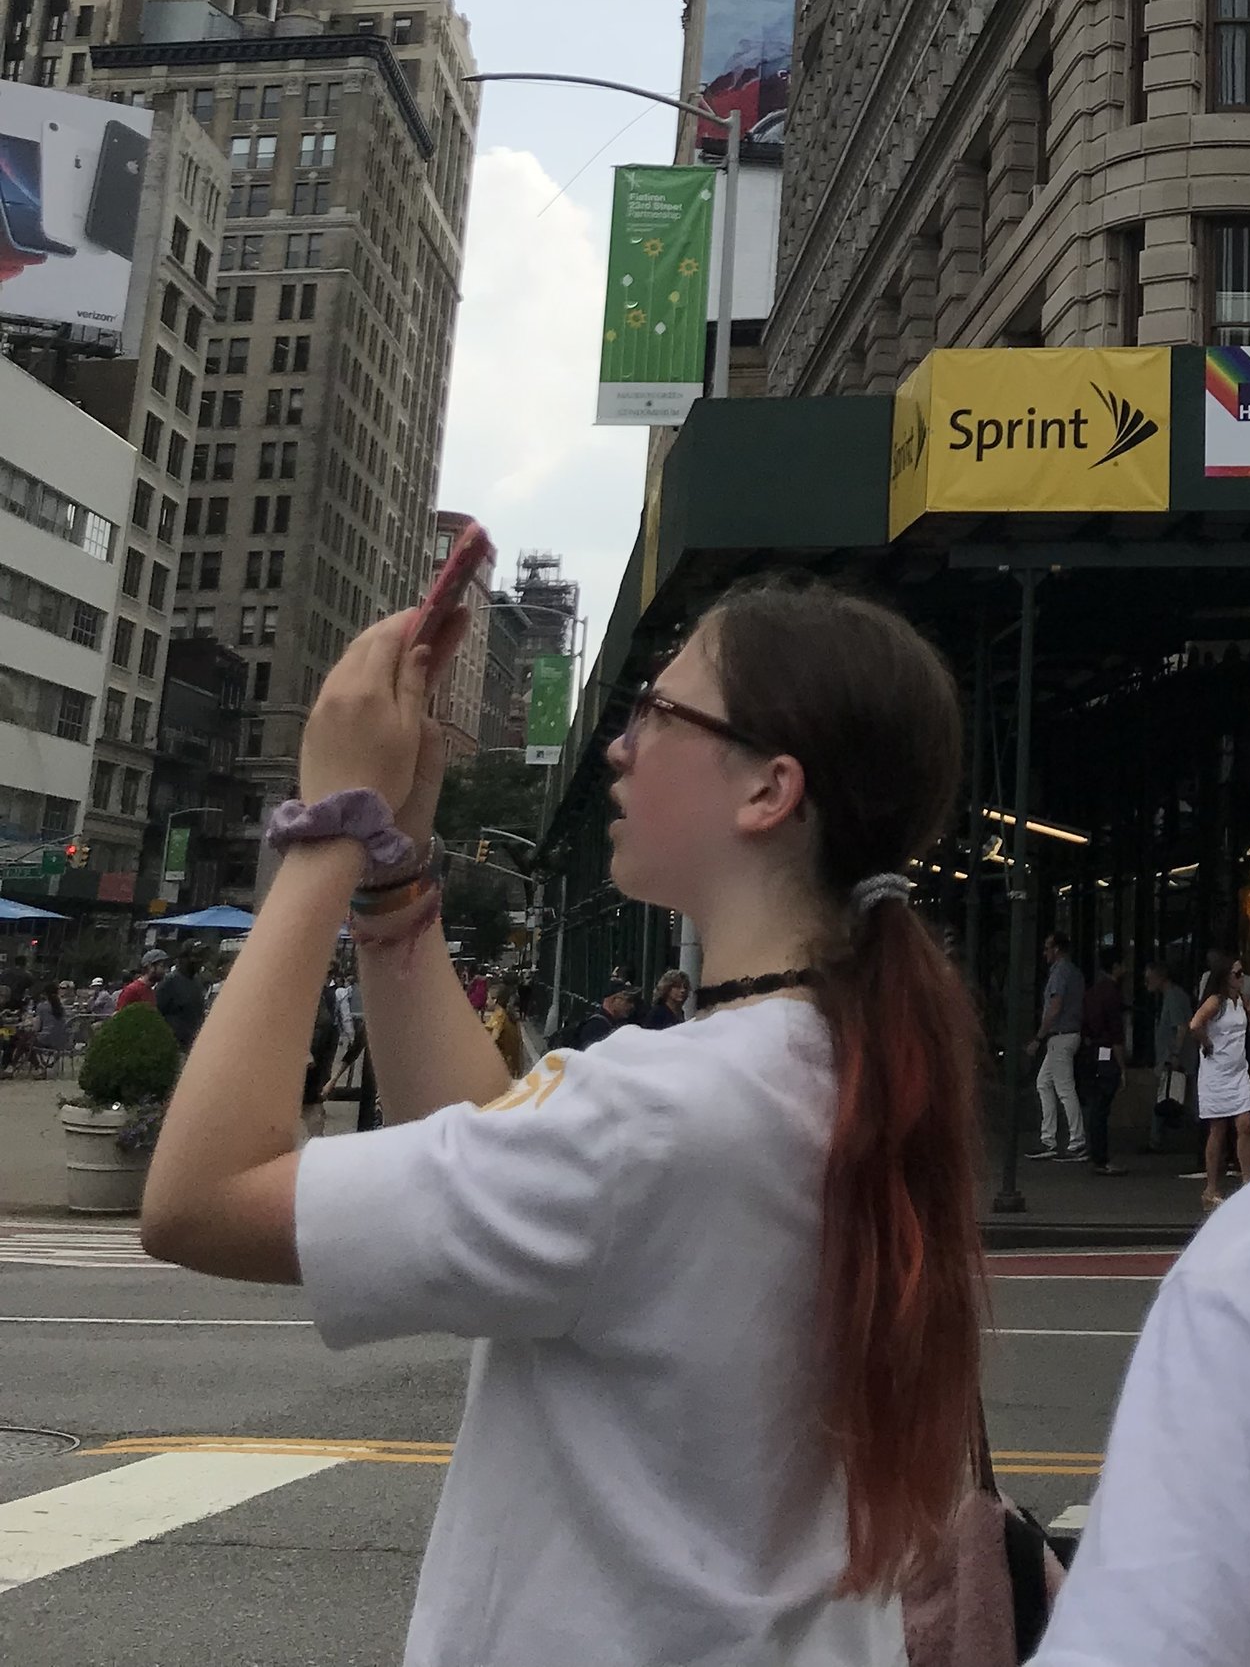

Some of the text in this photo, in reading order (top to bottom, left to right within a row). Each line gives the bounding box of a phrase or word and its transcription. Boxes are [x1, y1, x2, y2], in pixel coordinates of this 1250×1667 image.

[653, 202, 682, 211] Street
[77, 310, 113, 322] verizon
[949, 407, 1088, 462] Sprint
